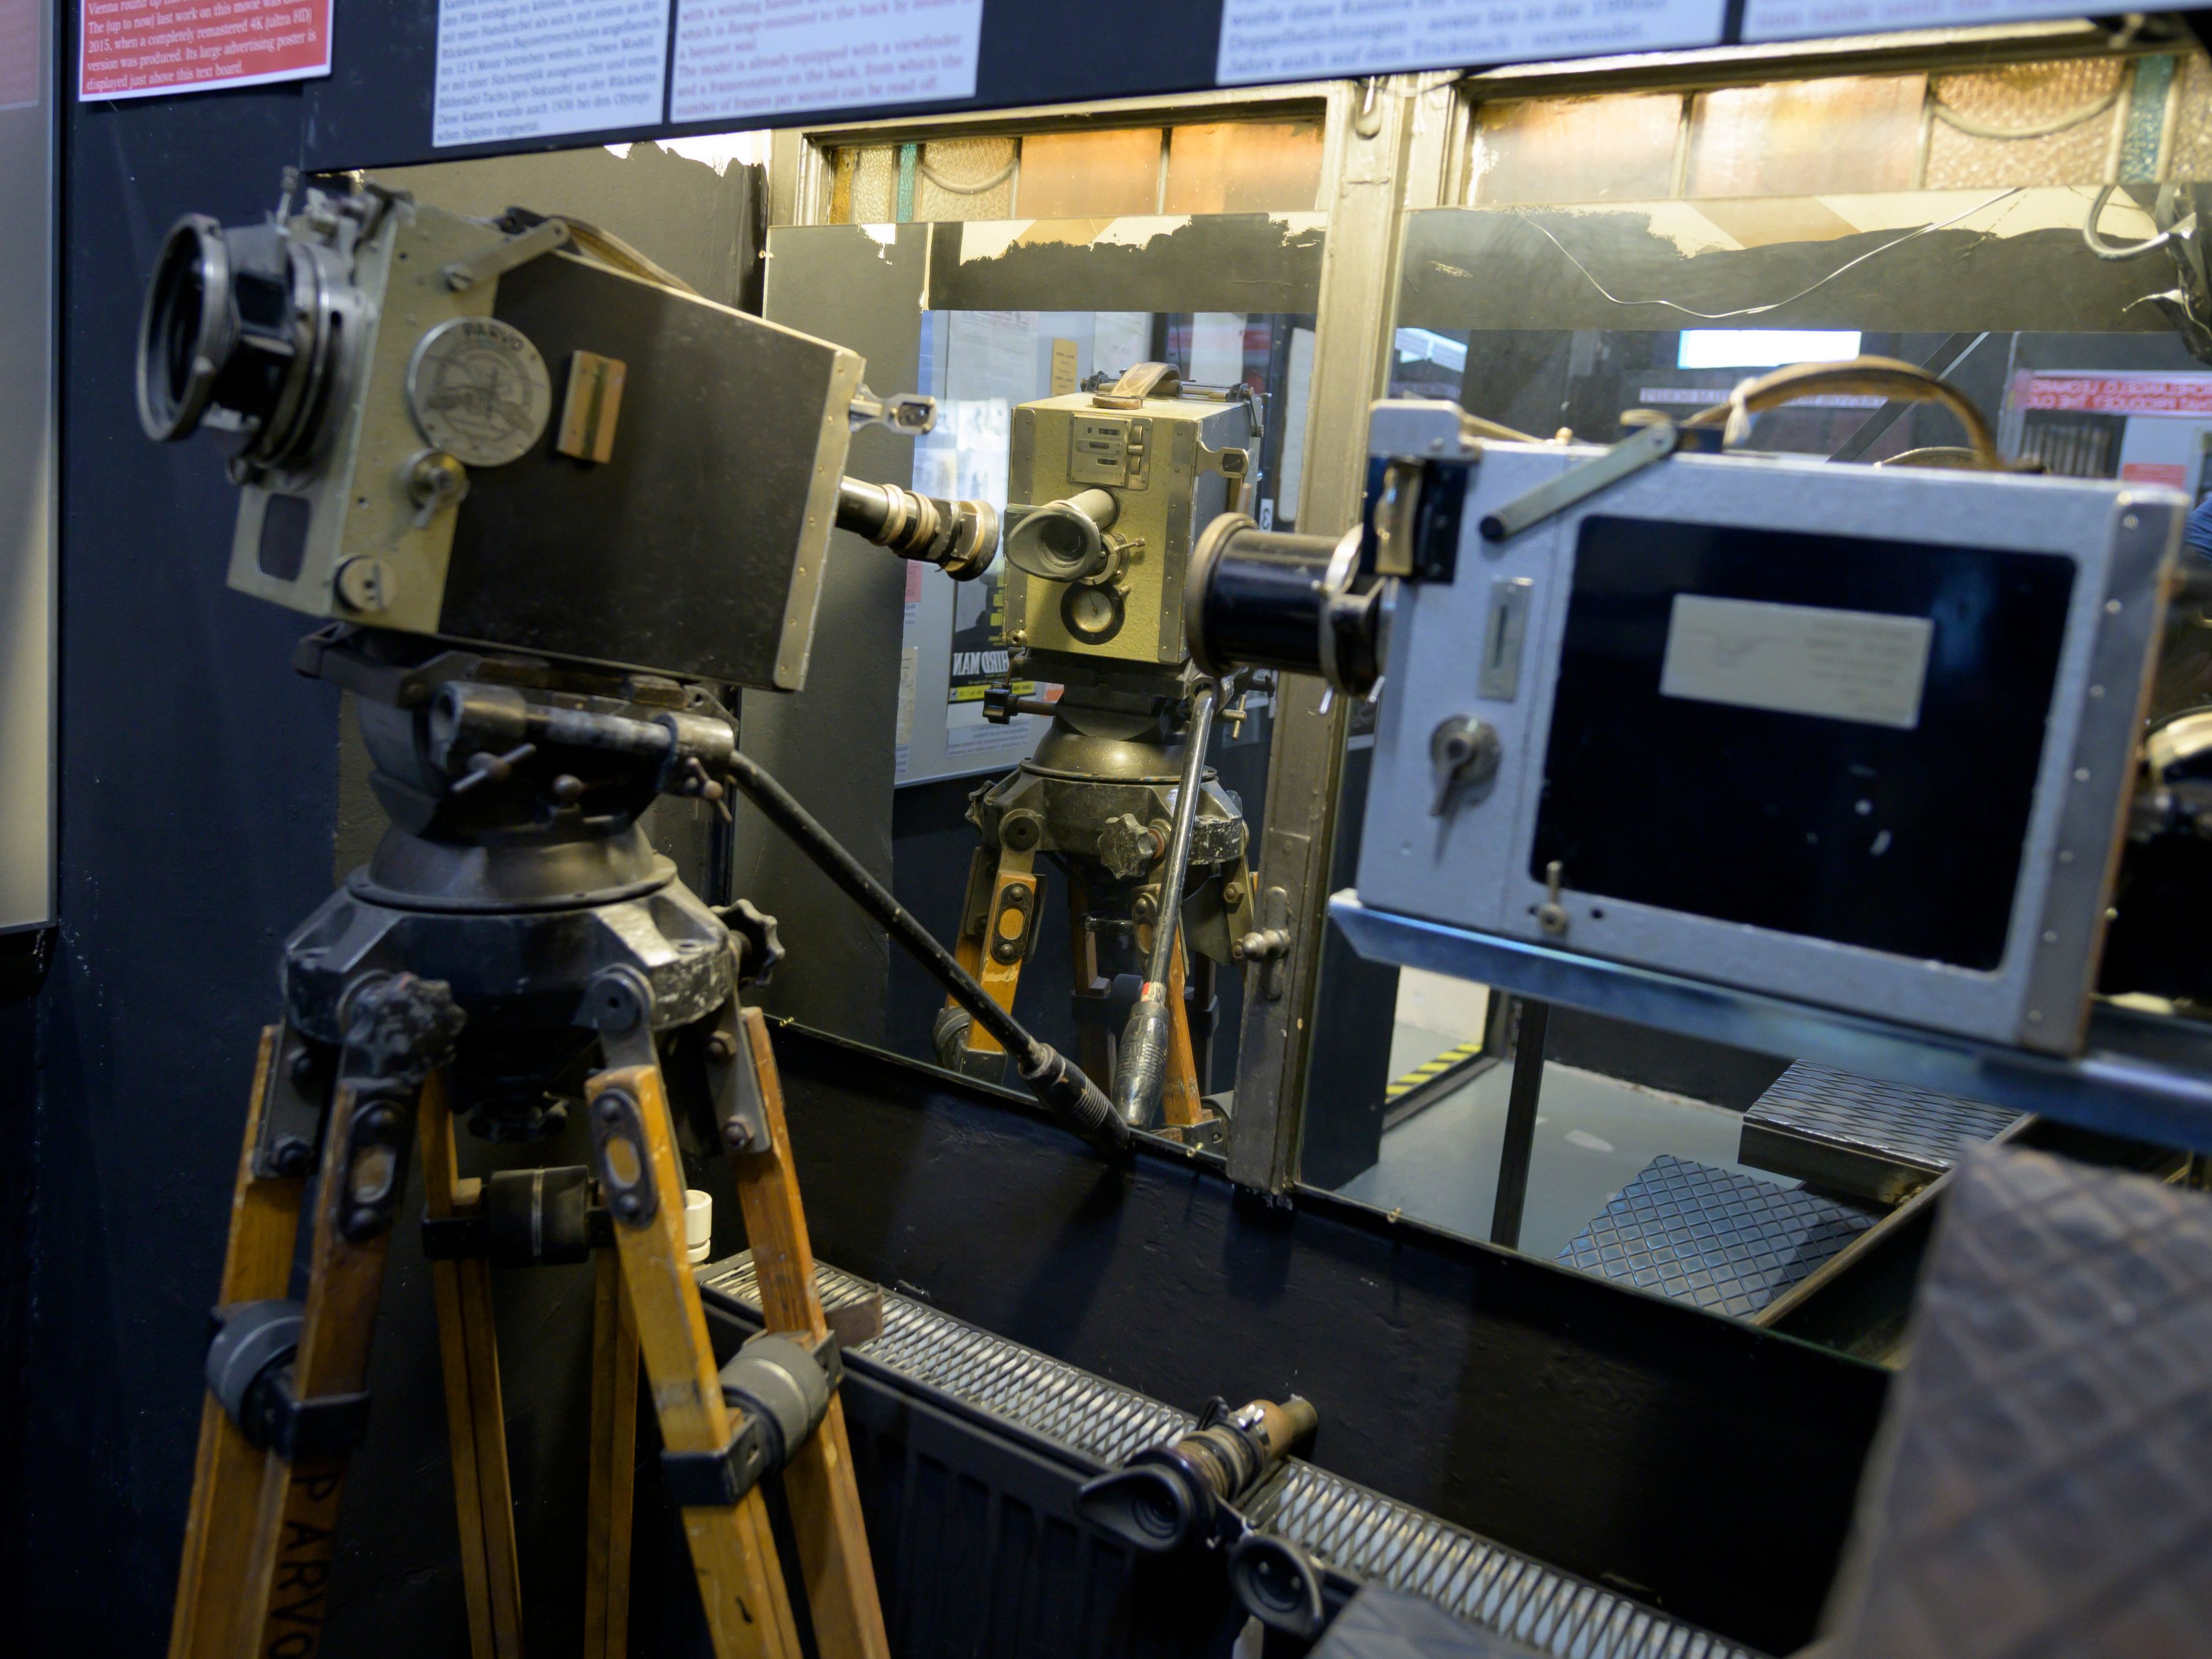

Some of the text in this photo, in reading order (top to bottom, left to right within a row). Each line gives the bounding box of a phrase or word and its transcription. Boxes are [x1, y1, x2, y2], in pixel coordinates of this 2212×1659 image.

[89, 3, 119, 15] Vienna
[121, 0, 147, 11] round
[89, 21, 104, 34] The
[106, 20, 121, 34] (up
[123, 19, 132, 30] to
[134, 15, 155, 29] now)
[157, 12, 173, 25] last
[175, 7, 198, 22] work
[200, 8, 212, 18] on
[214, 2, 231, 17] this
[233, 0, 260, 14] movie
[550, 12, 573, 25] auch
[114, 37, 138, 50] when
[139, 37, 146, 46] a
[148, 28, 195, 46] completely
[197, 18, 248, 39] remastered
[249, 15, 264, 31] 4K
[265, 12, 291, 31] (ultra
[292, 7, 312, 25] HD)
[87, 58, 119, 72] version
[120, 58, 138, 67] was
[185, 48, 198, 60] Its
[200, 45, 222, 61] large
[224, 37, 275, 55] advertising
[276, 32, 306, 51] poster
[308, 28, 317, 42] is
[86, 59, 244, 92] displayed just above this text board.
[269, 1474, 338, 1659] PARVO
